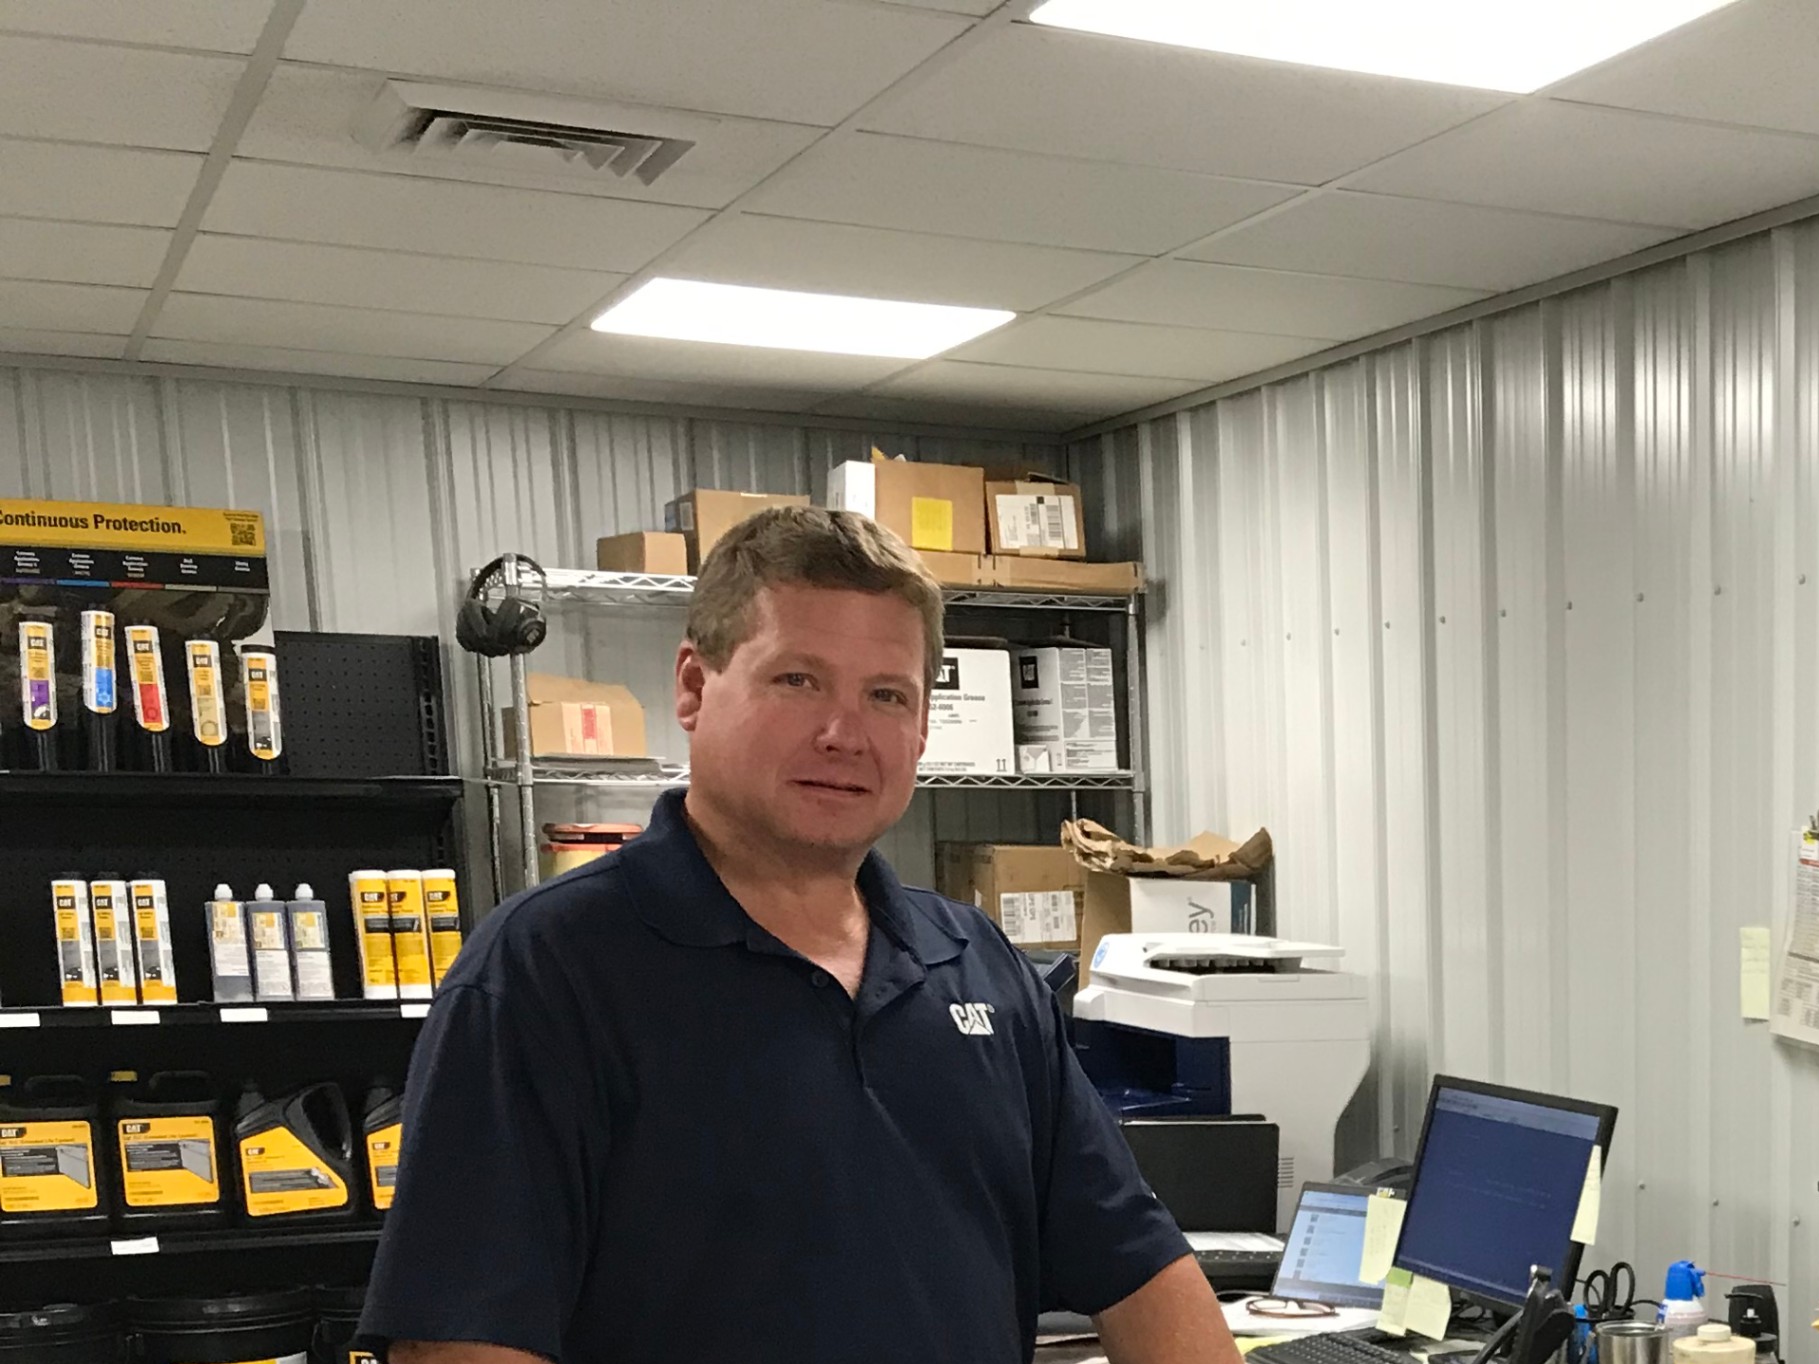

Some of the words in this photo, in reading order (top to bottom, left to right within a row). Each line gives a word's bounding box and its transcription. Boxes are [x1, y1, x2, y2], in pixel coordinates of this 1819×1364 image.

[93, 514, 187, 535] Protection.
[937, 666, 955, 682] AT
[949, 1002, 994, 1035] CAT
